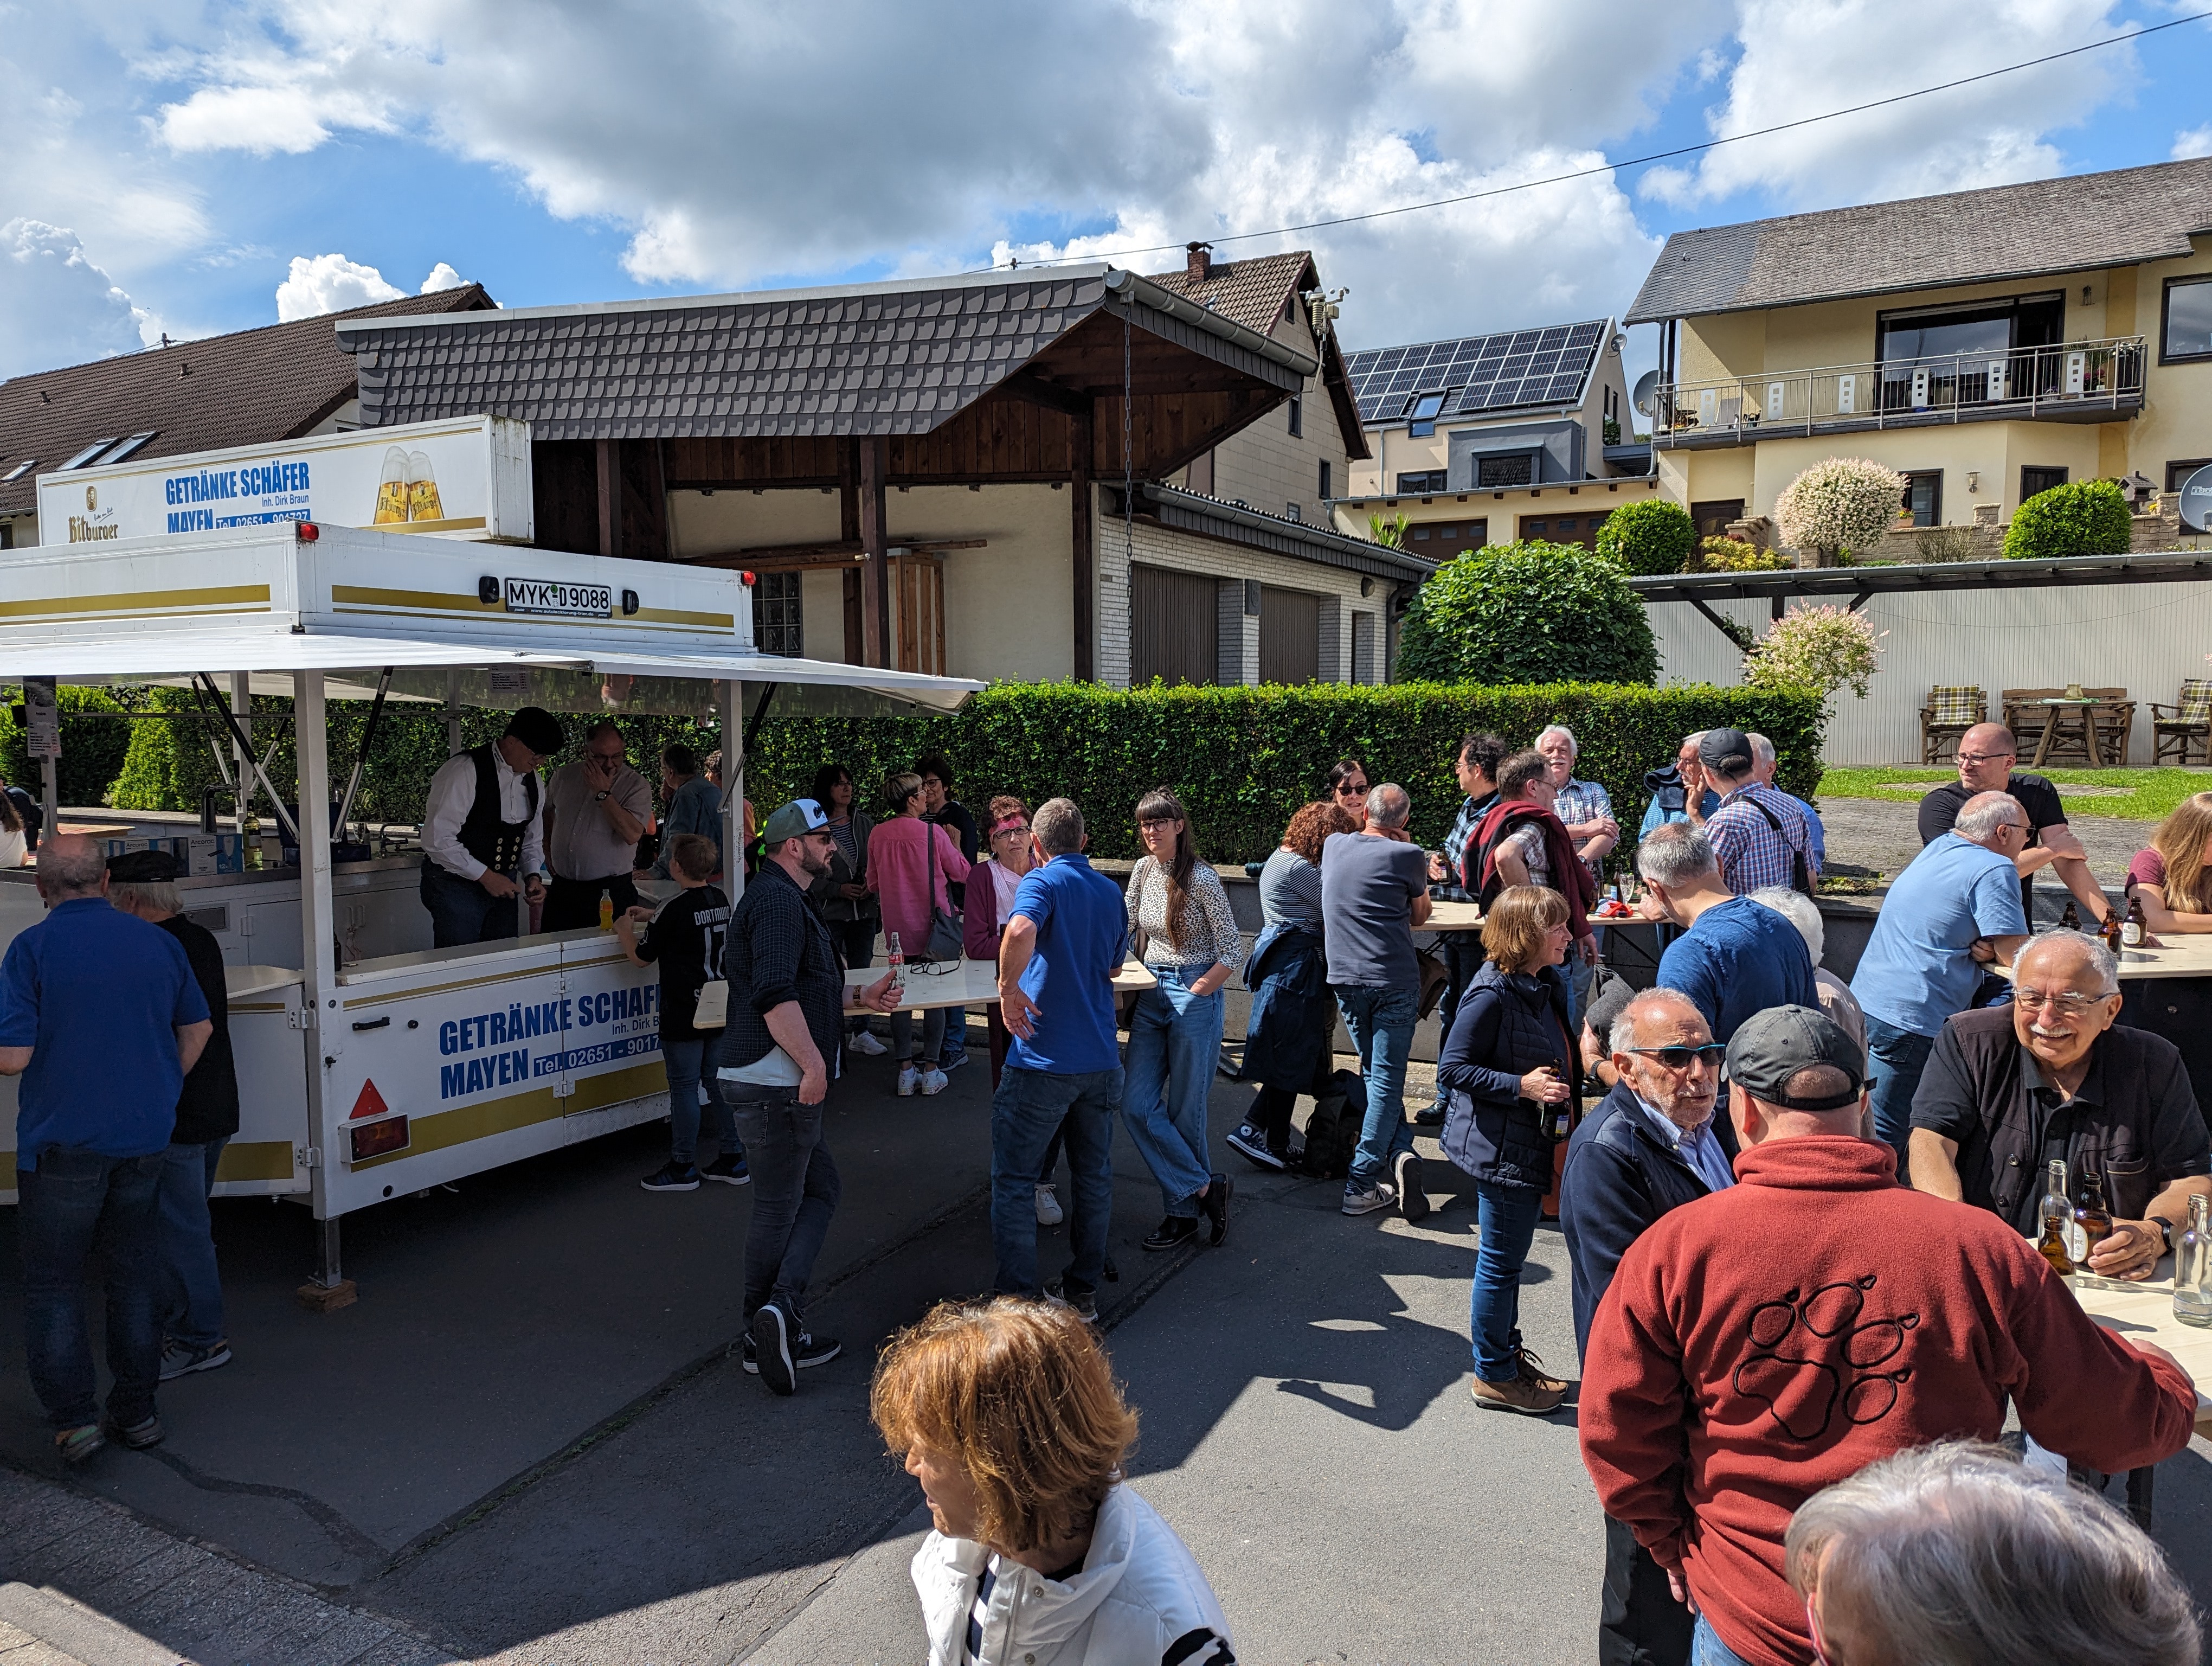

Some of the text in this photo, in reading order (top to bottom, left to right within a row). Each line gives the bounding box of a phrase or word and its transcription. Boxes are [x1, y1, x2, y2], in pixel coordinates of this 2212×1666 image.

[166, 460, 310, 505] GETRÄNKE SCHÄFER
[262, 494, 309, 508] Inh. Dirk Braun
[69, 515, 118, 543] Bitburger
[440, 983, 660, 1056] GETRÄNKE SCHAF
[612, 1023, 629, 1035] Inh.
[632, 1016, 651, 1031] Dirk
[441, 1048, 529, 1100] MAYEN
[536, 1056, 563, 1073] Tel.
[568, 1043, 612, 1068] 02651
[627, 1034, 659, 1055] 9017
